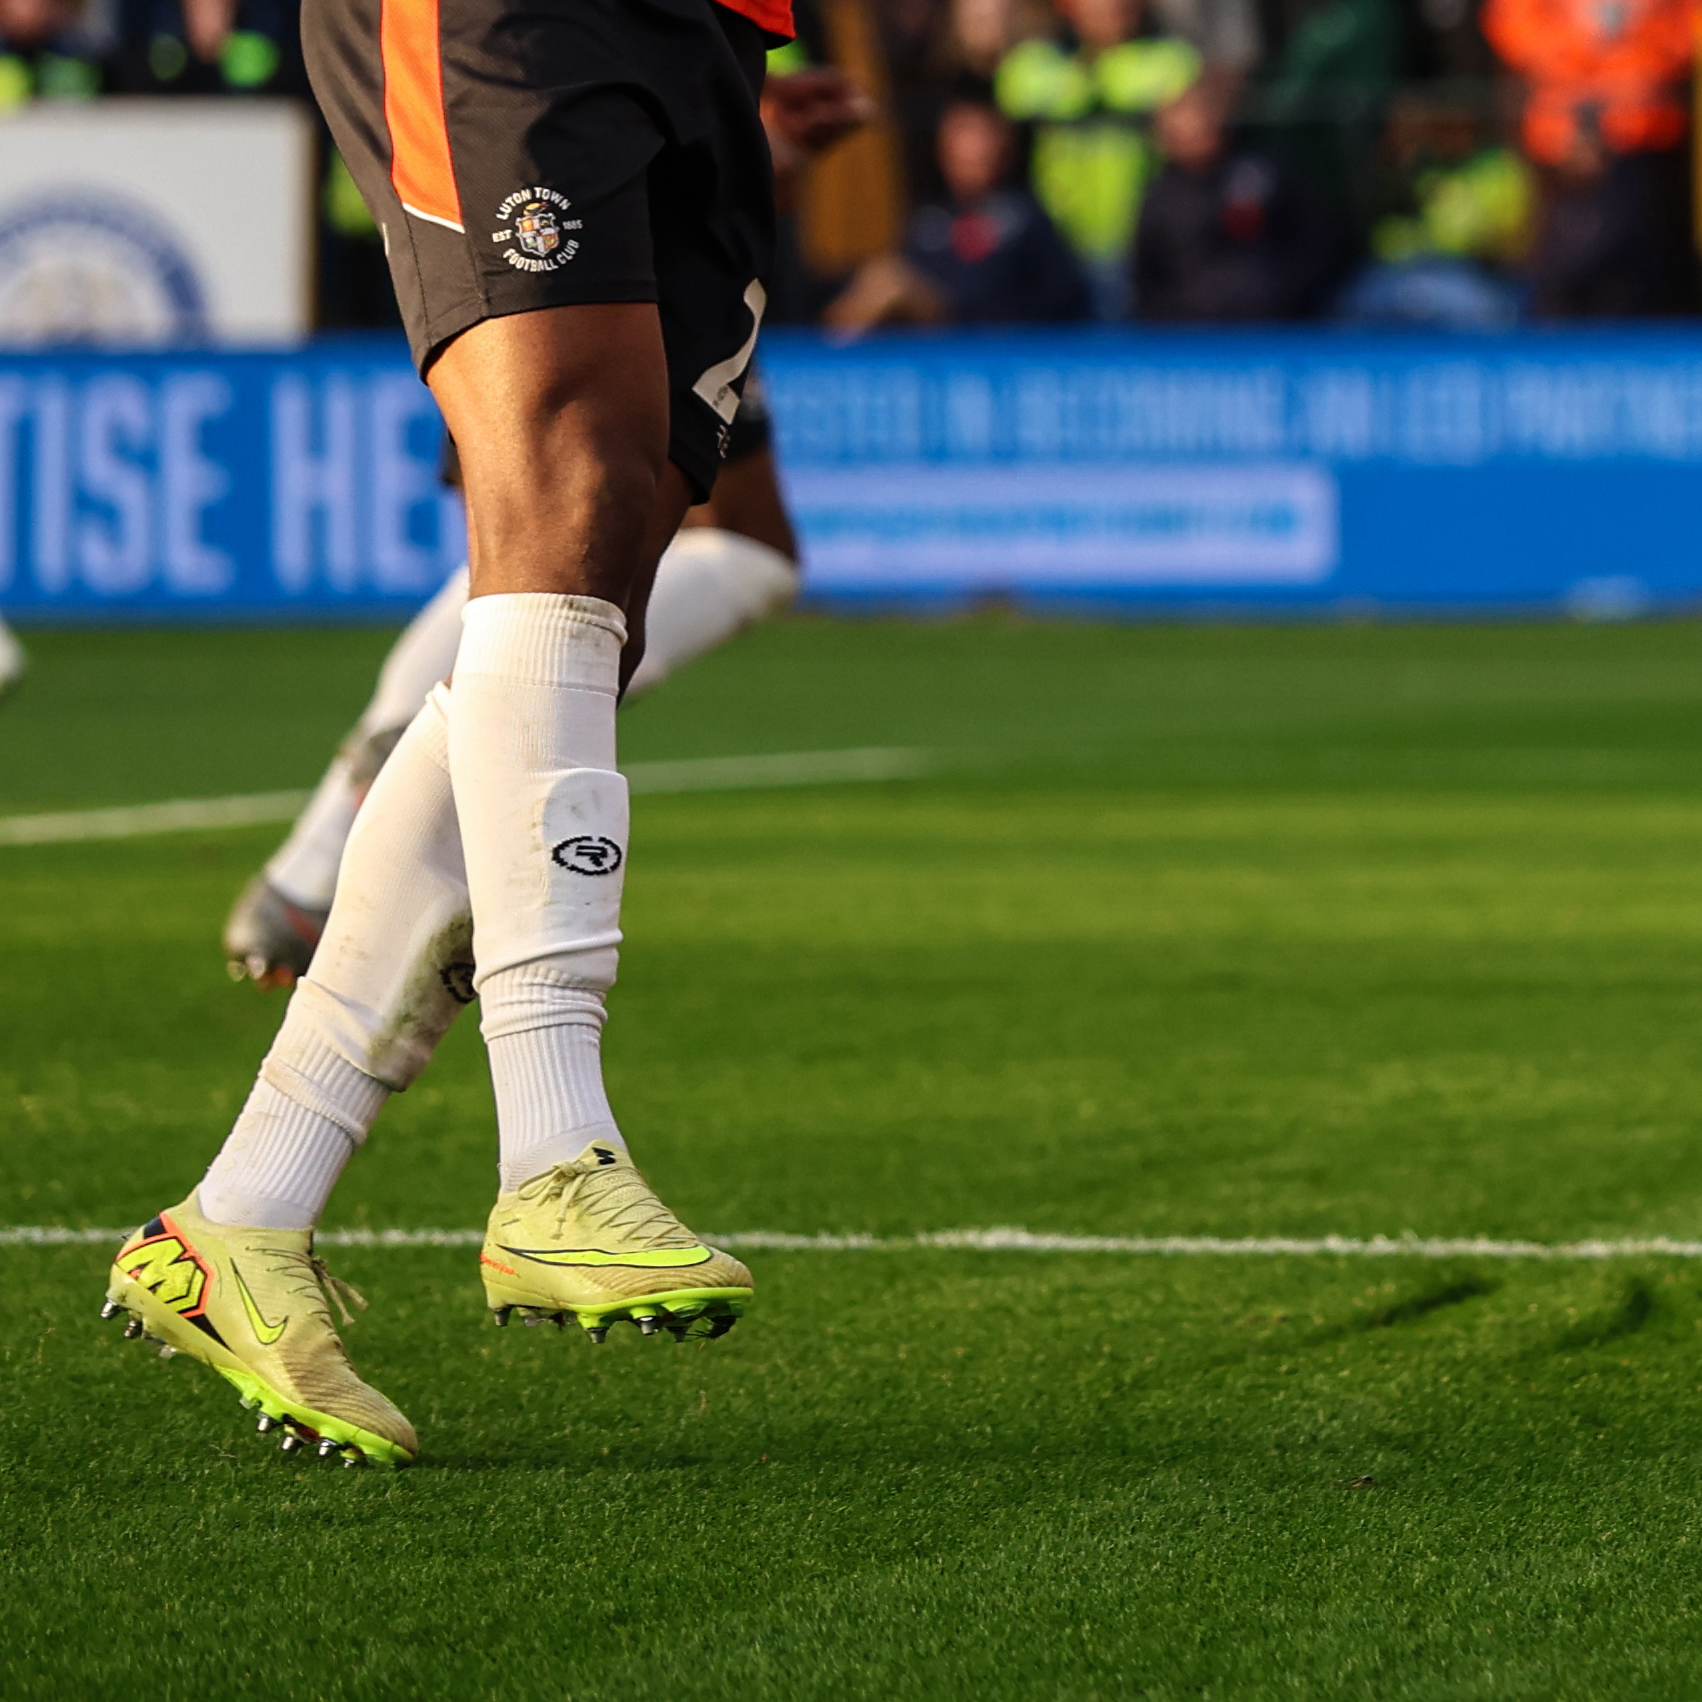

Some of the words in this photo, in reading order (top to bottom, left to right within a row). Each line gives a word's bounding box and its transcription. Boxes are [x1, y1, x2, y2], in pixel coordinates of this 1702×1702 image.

[495, 188, 533, 220] LUTON
[534, 187, 572, 210] TOWN
[491, 229, 512, 242] EST
[503, 248, 559, 272] FOOTBALL
[556, 239, 579, 264] CLUB
